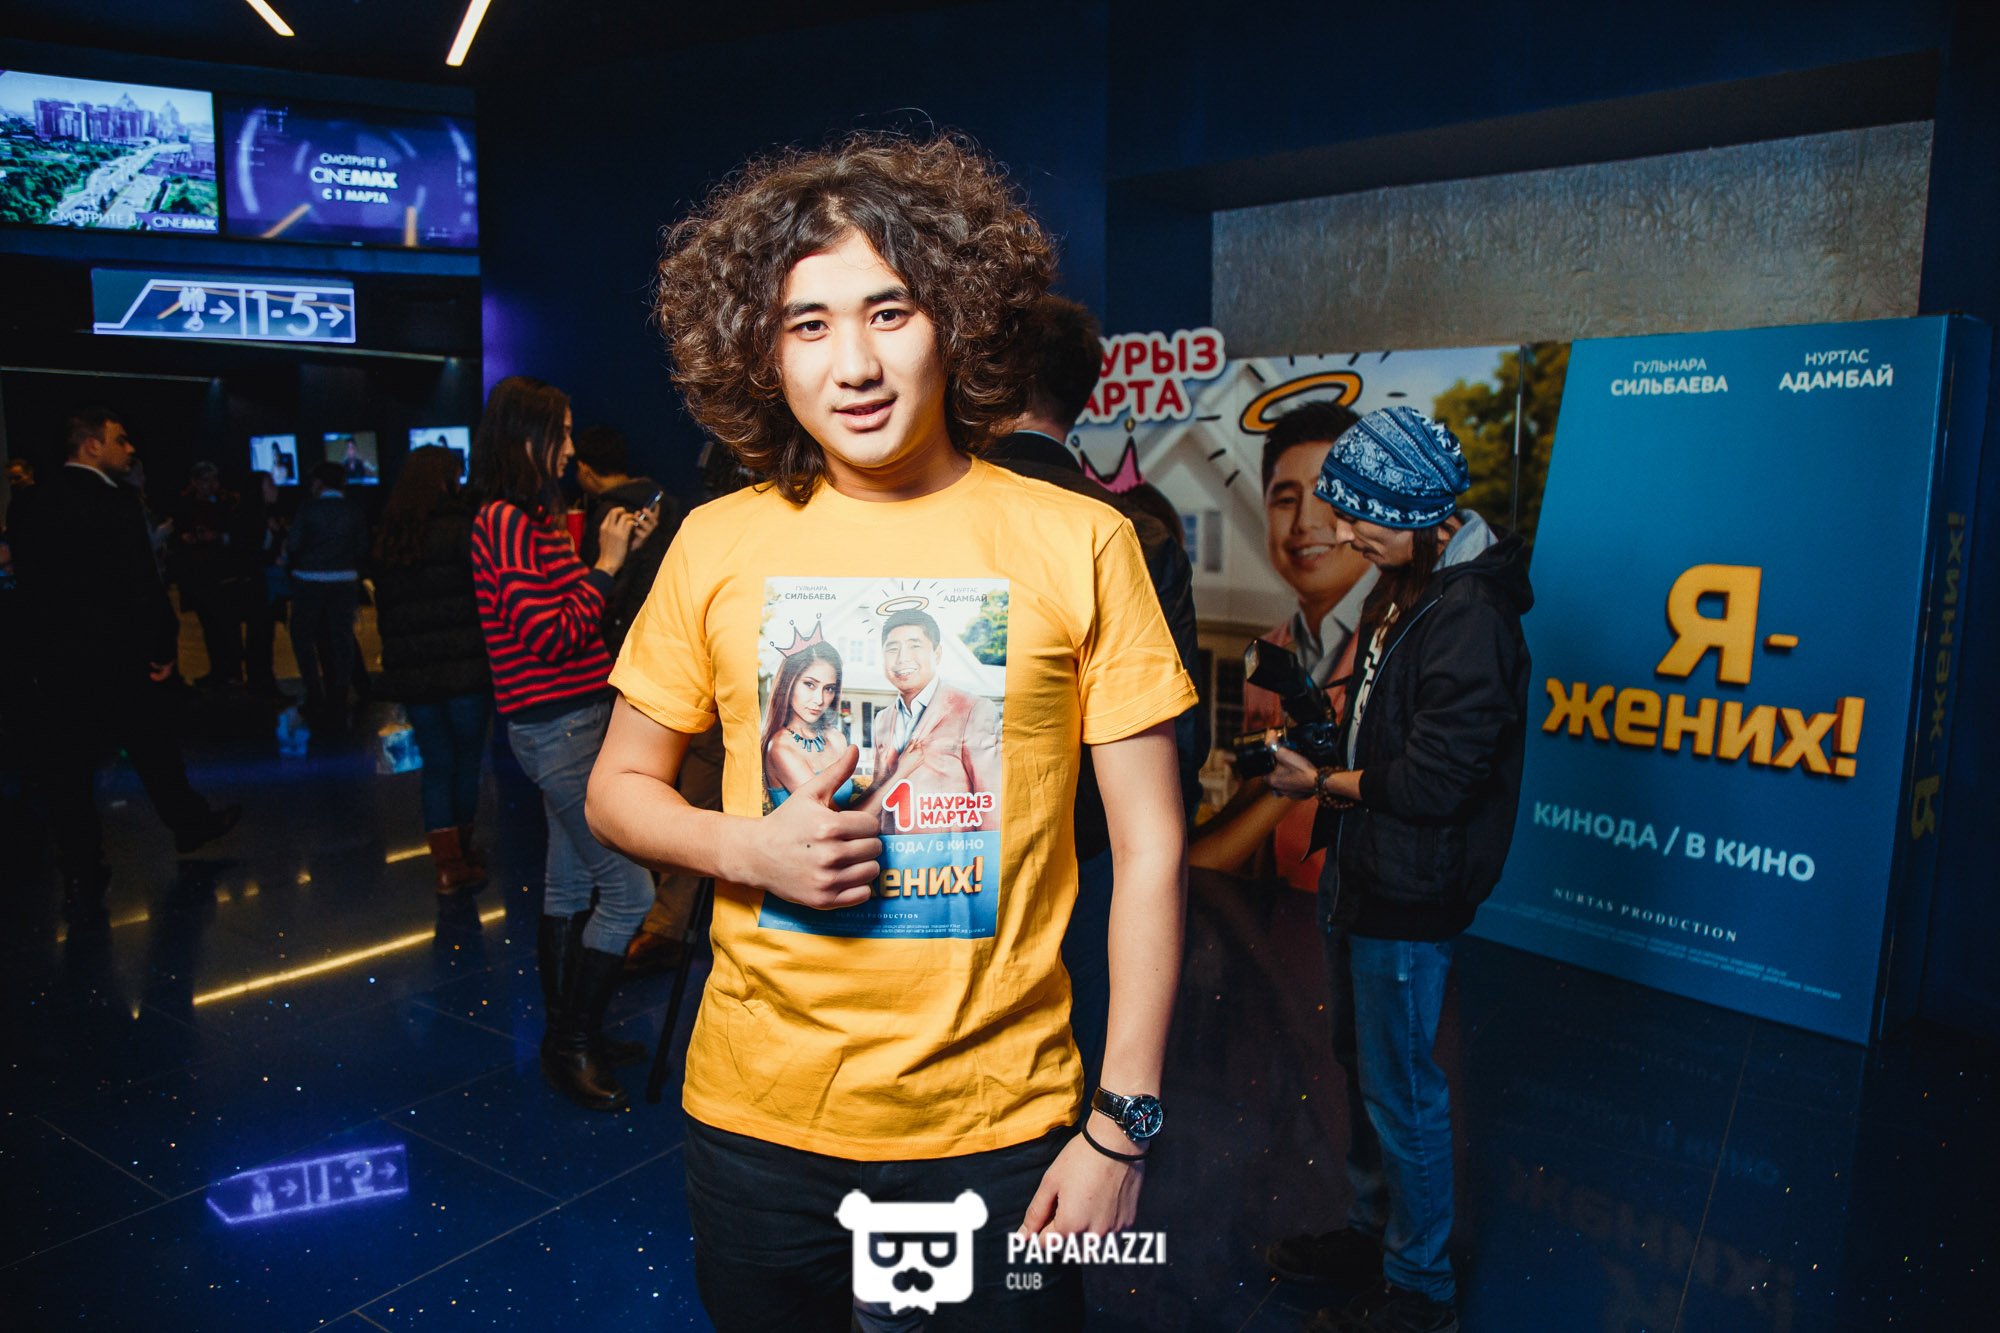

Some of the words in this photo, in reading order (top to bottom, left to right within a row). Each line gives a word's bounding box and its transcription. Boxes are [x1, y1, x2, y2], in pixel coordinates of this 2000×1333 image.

[310, 166, 399, 189] CINEMAX
[335, 188, 342, 200] 1
[345, 190, 389, 204] МАРТА
[50, 209, 125, 226] СМОТРИТЕ
[152, 215, 217, 231] CINEMAX
[1100, 335, 1219, 378] УРЫЗ
[1633, 358, 1707, 375] ГУЛЬНАРА
[1804, 348, 1869, 366] НУРТАС
[1611, 373, 1728, 397] СИЛЬБАЕВА
[1779, 362, 1894, 393] АДАМБАЙ
[1085, 378, 1184, 416] АРТА
[784, 592, 837, 601] СИЛЬБАЕВА
[943, 594, 988, 603] АДАМБАЙ
[1542, 677, 1866, 779] жених!
[885, 782, 911, 828] 1
[919, 794, 993, 811] НАУРЫЗ
[920, 809, 979, 825] МАРТА
[936, 841, 944, 851] В
[947, 839, 985, 851] КИНО
[1533, 801, 1659, 851] КИНОДА
[1686, 832, 1707, 860] В
[1714, 838, 1816, 883] КИНО
[871, 856, 985, 898] ених!
[1553, 887, 1614, 913] NURTAS
[1620, 903, 1738, 943] PRODUCTION
